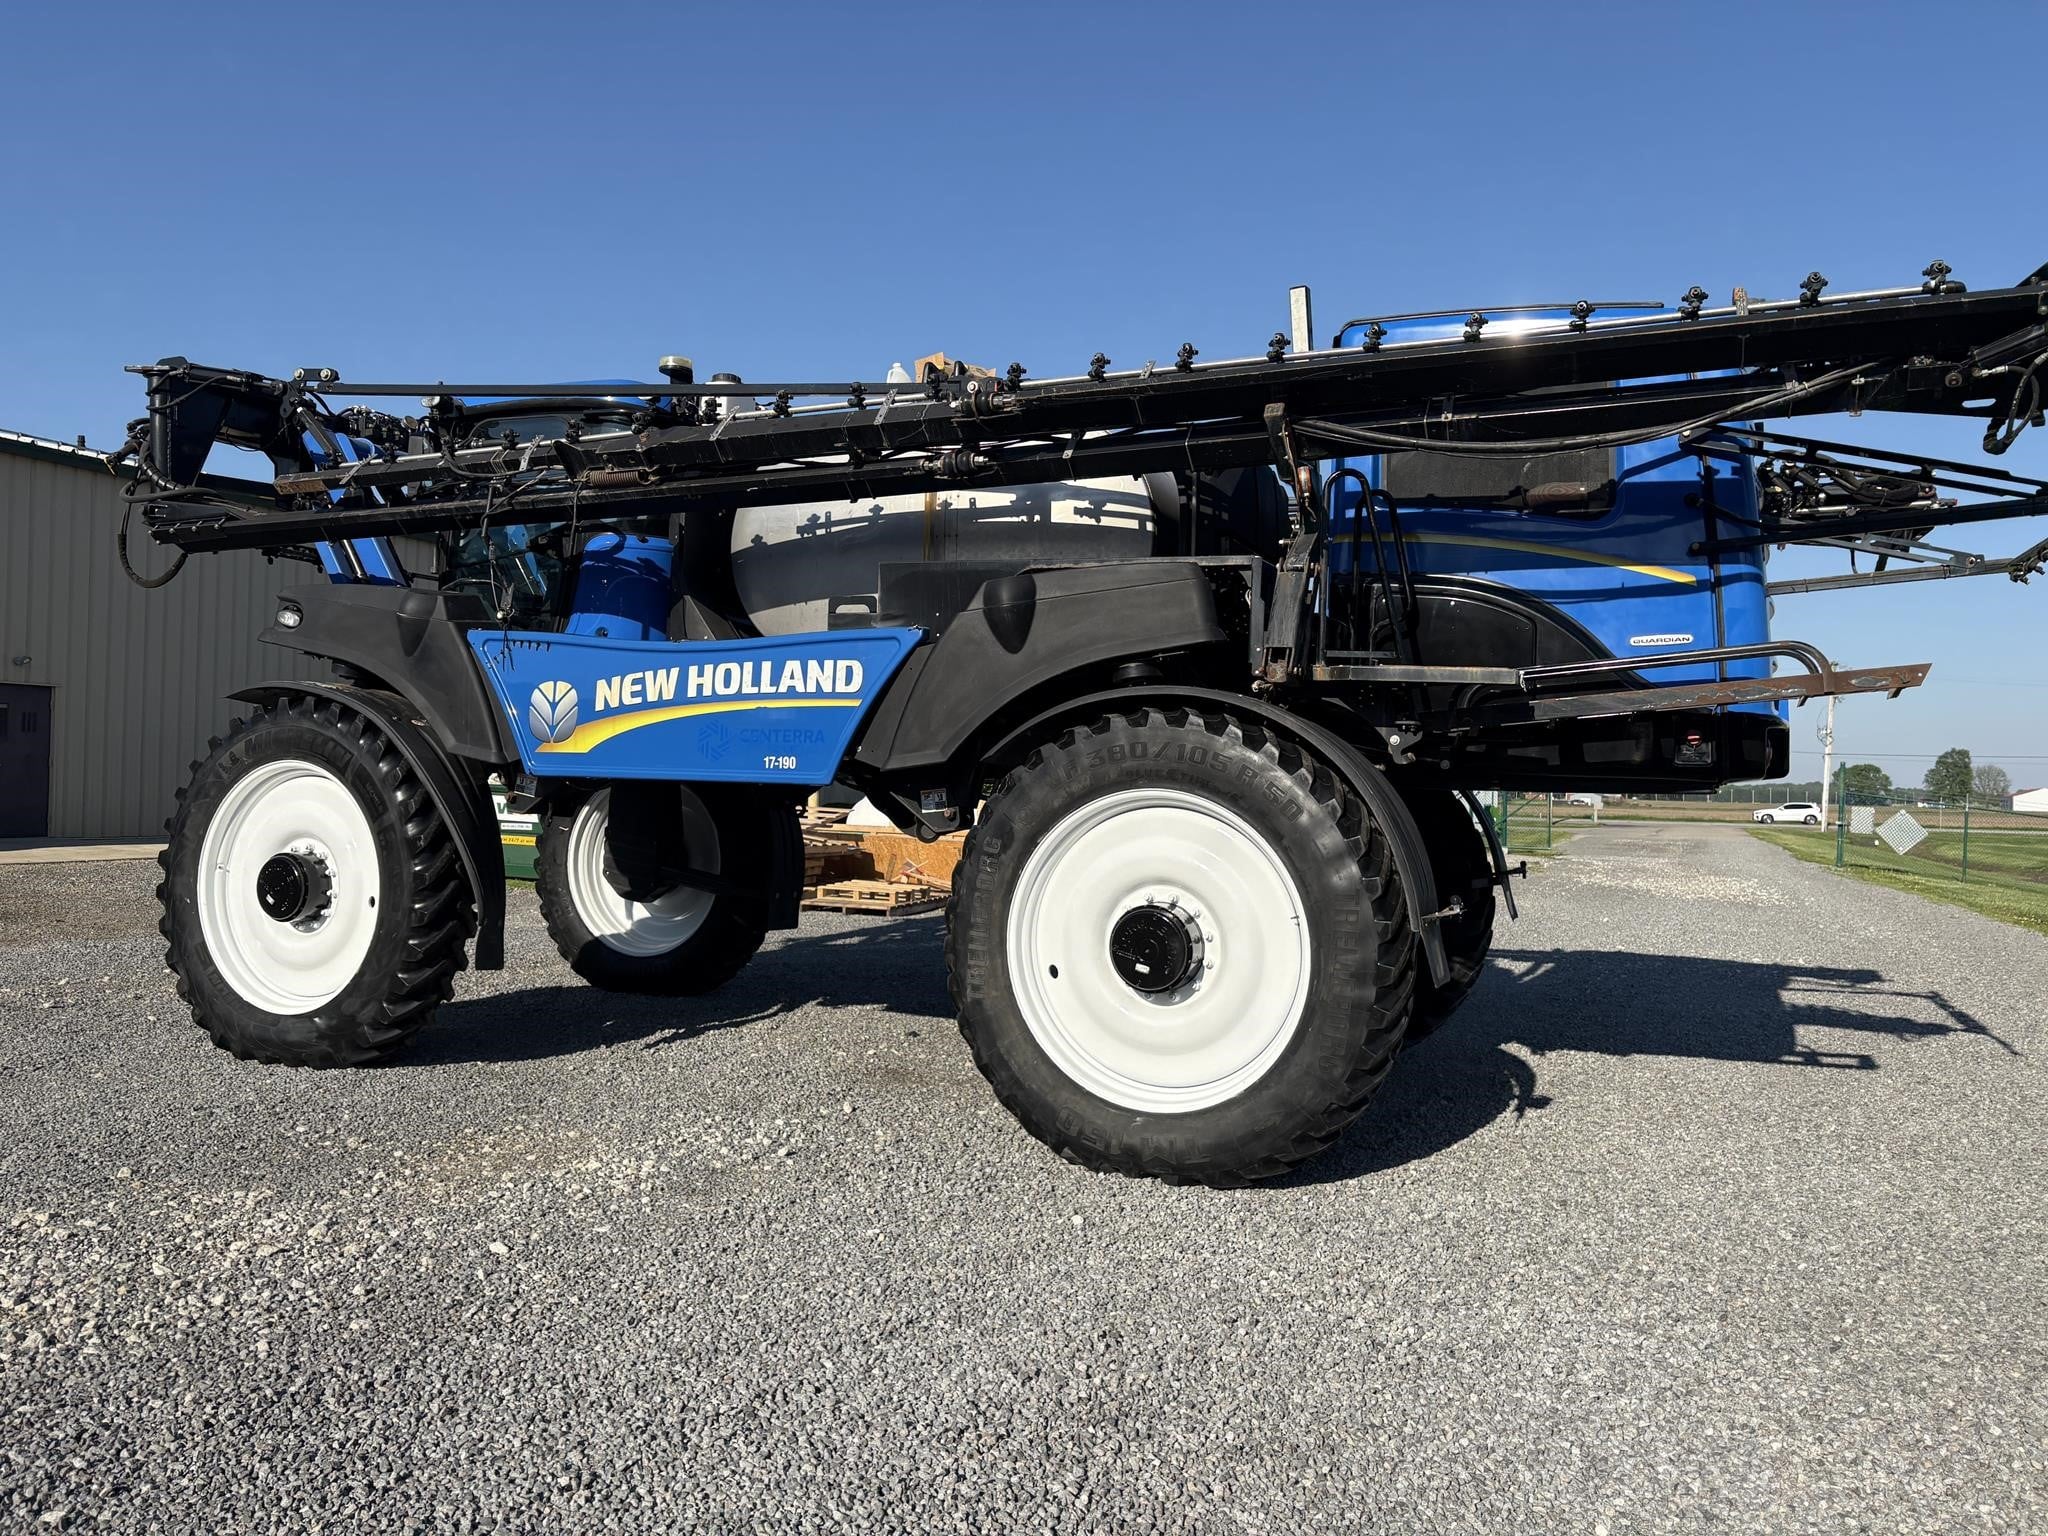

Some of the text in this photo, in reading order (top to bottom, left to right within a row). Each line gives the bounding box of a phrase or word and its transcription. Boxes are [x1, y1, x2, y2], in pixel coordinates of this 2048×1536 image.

[1633, 636, 1690, 644] GUARDIAN
[594, 659, 864, 712] NEW HOLLAND
[763, 756, 797, 769] 17-190
